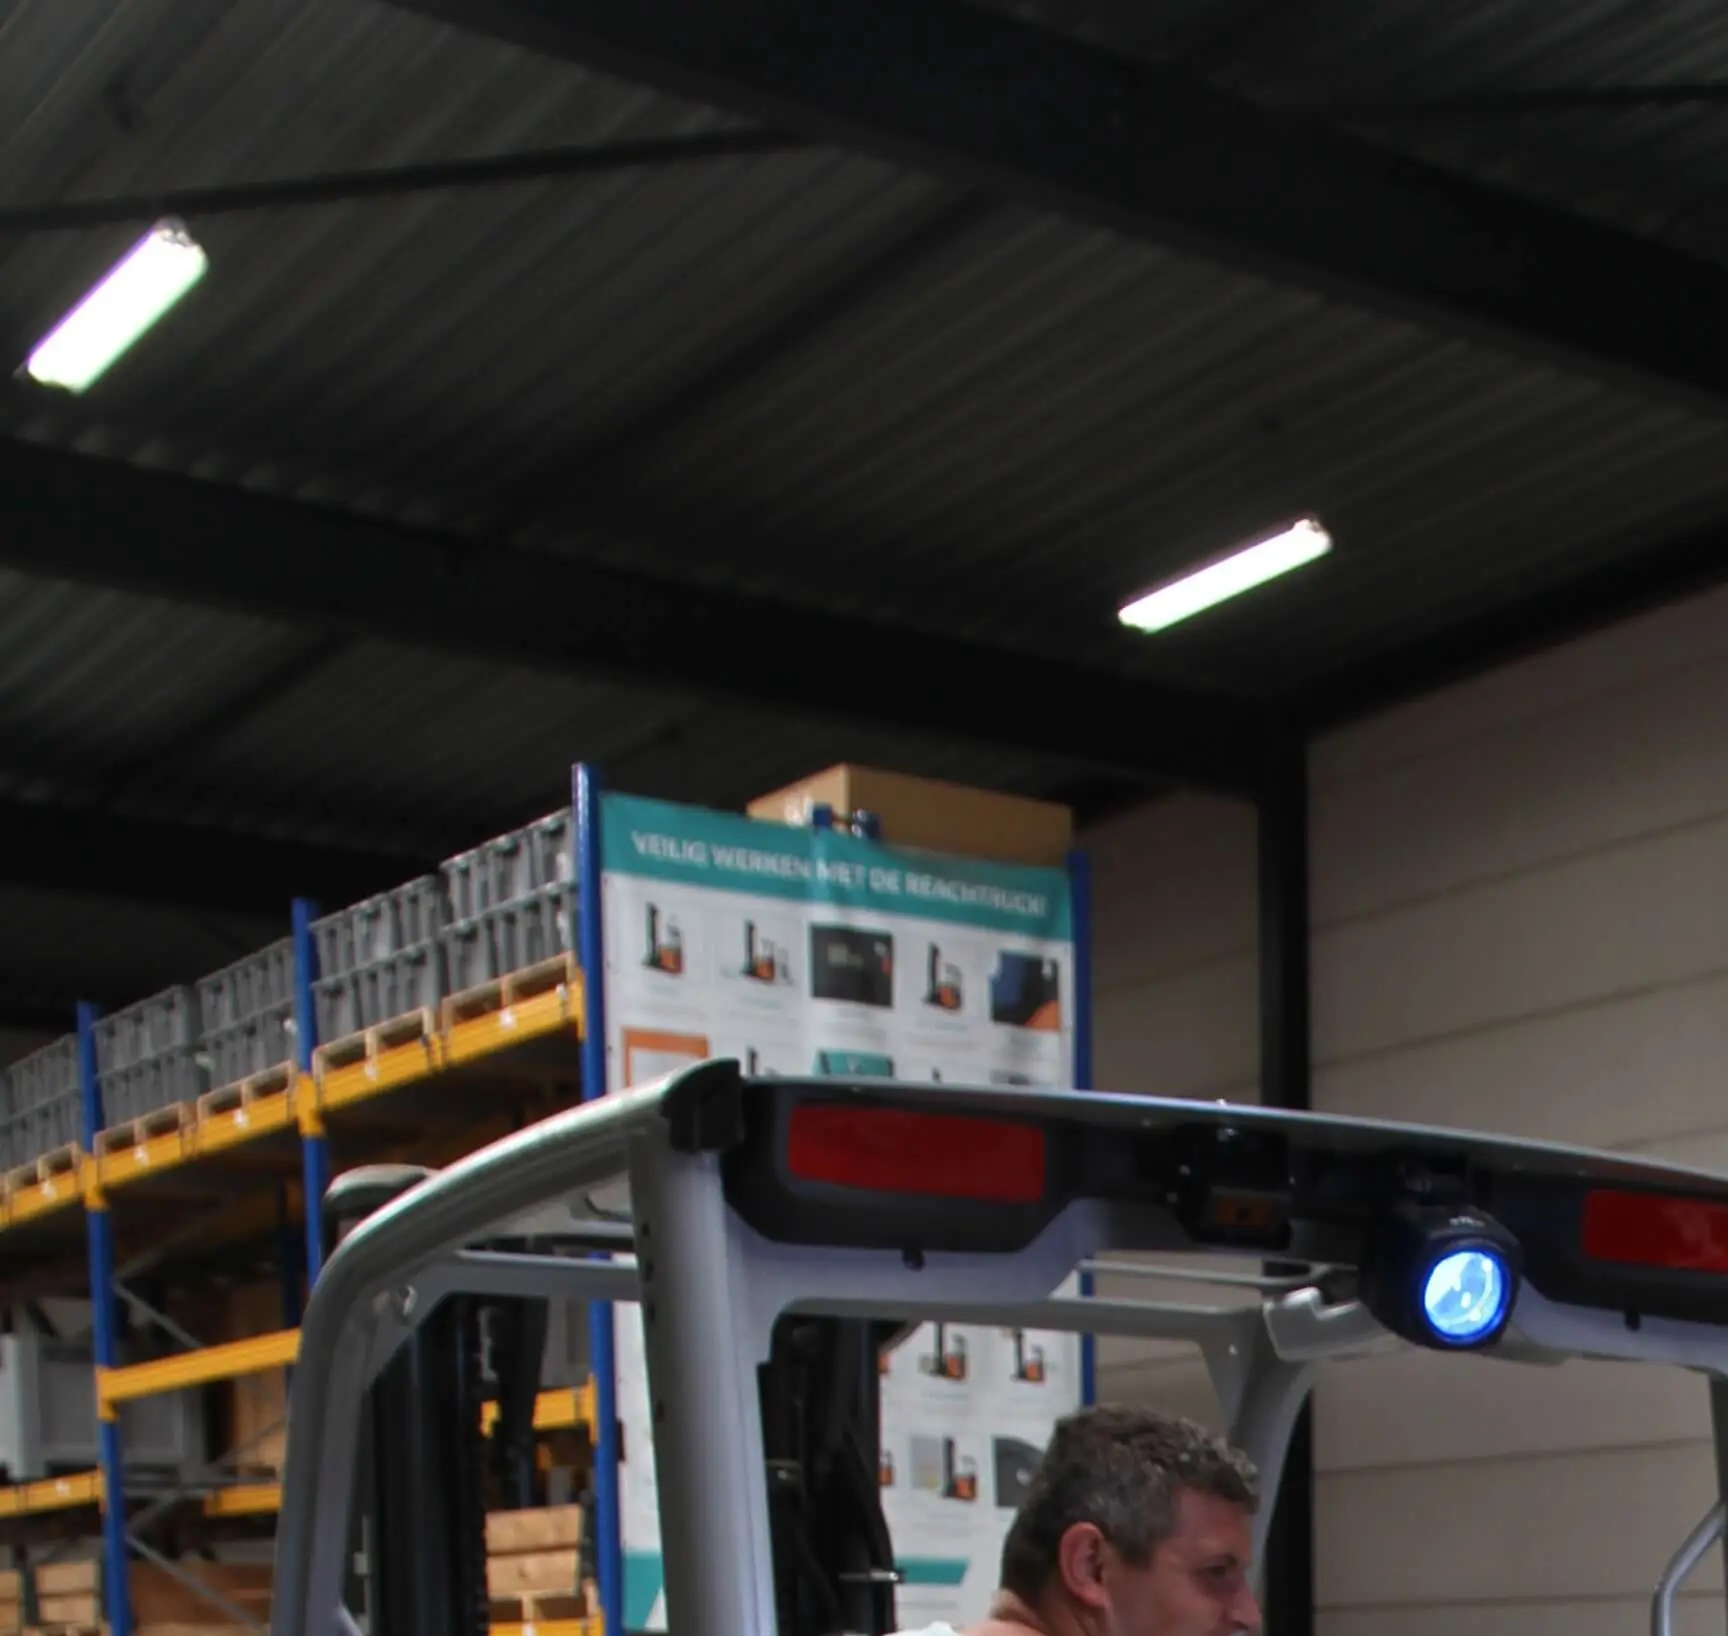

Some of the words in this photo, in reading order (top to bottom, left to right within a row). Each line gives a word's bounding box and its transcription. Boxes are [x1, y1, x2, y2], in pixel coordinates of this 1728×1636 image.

[632, 830, 708, 867] VEILIG
[711, 842, 812, 879] WERKEN
[868, 866, 901, 894] DE
